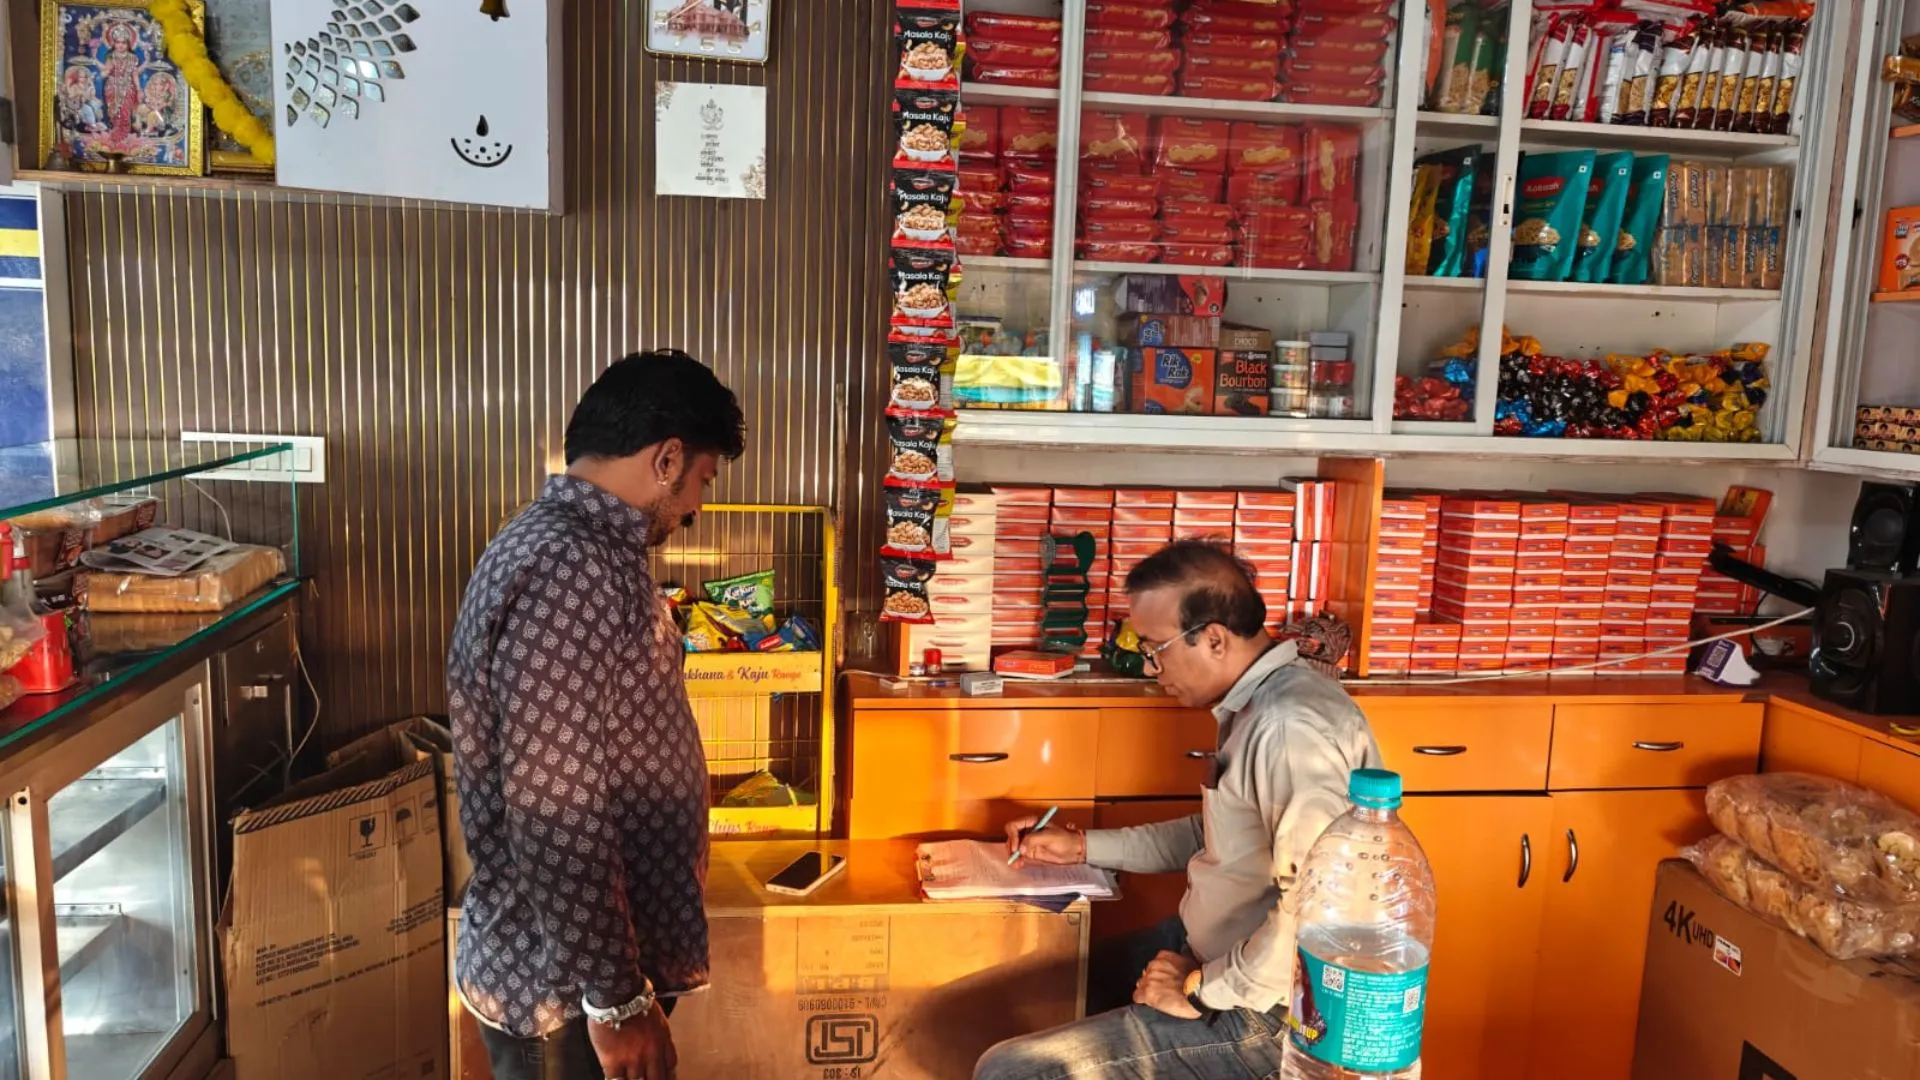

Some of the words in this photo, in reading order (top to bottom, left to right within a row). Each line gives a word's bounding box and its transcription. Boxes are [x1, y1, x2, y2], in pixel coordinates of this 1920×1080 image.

[903, 29, 933, 39] Masala
[902, 111, 931, 120] Masala
[933, 113, 951, 124] Kaju
[899, 191, 929, 201] Masala
[1160, 353, 1181, 368] Rik
[1235, 359, 1268, 375] Black
[1219, 373, 1267, 389] Bourbon
[737, 665, 769, 683] Kaju
[771, 667, 802, 682] Range
[1663, 900, 1696, 945] 4K
[1692, 920, 1715, 949] UHD
